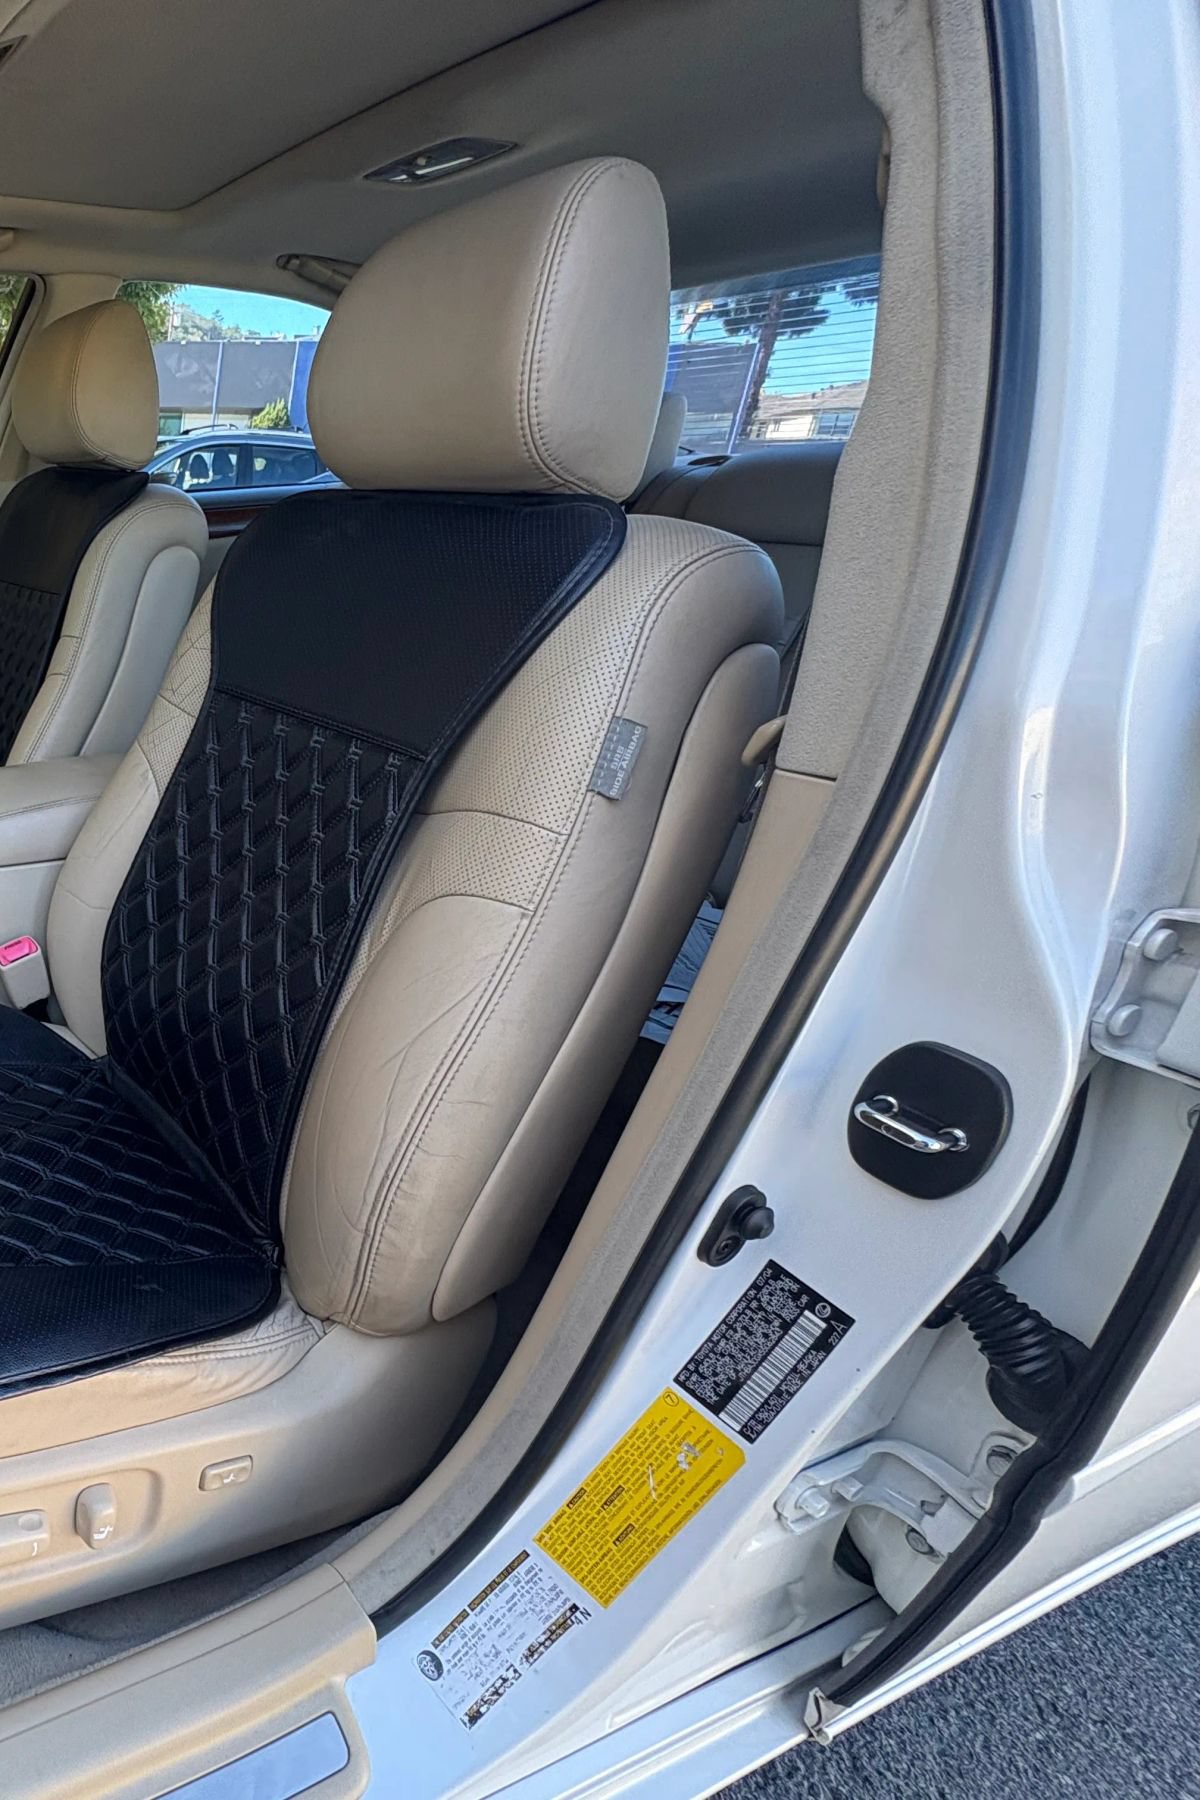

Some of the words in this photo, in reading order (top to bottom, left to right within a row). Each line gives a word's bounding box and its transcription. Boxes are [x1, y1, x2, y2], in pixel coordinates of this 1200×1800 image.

[696, 1342, 714, 1361] TOYOTA
[712, 1324, 728, 1342] MOTOR
[726, 1289, 757, 1324] CORPORATION
[757, 1268, 773, 1286] 07/04
